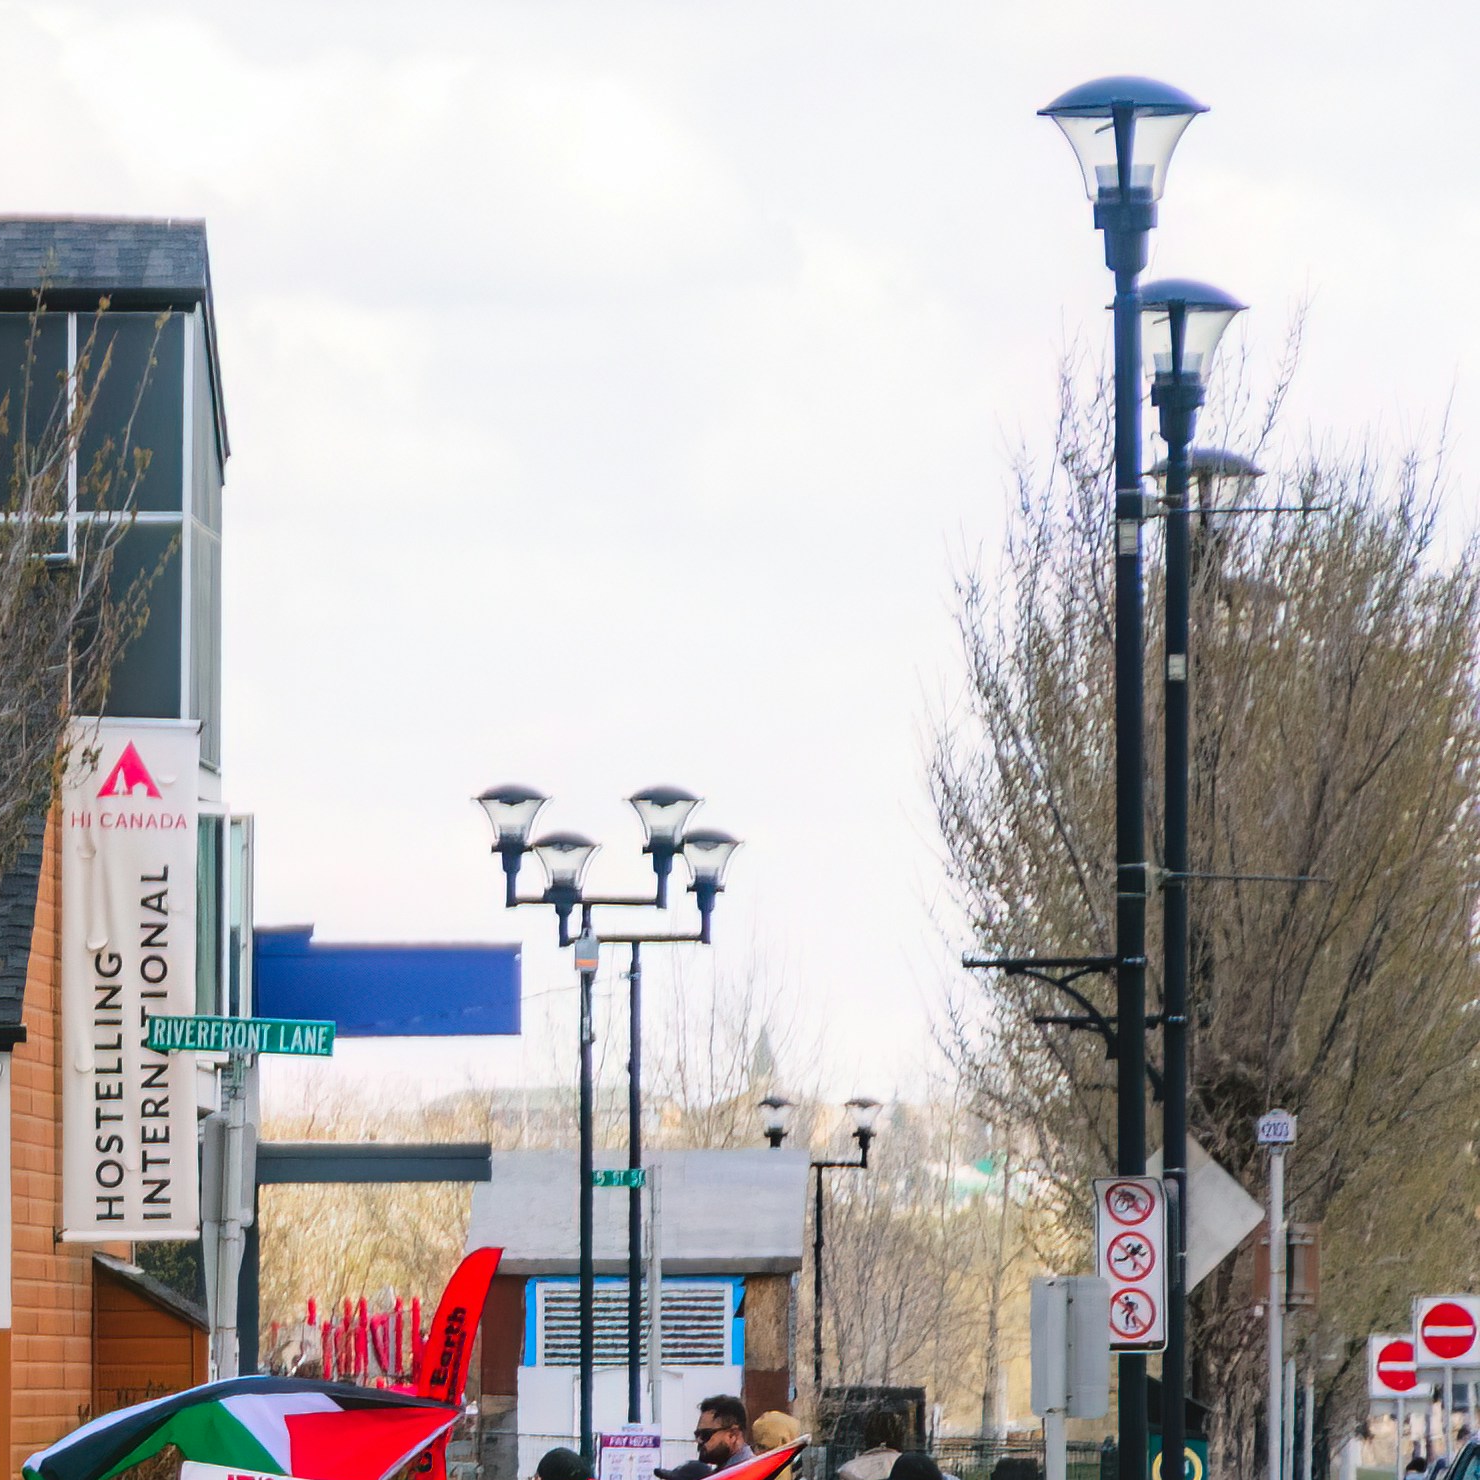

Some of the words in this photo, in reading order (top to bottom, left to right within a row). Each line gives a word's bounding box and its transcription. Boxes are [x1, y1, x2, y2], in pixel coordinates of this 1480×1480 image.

[71, 811, 91, 828] HI
[100, 812, 187, 829] CANADA
[153, 1018, 272, 1051] RIVERFRONT
[279, 1024, 329, 1054] LANE
[94, 952, 125, 1221] HOSTELLING
